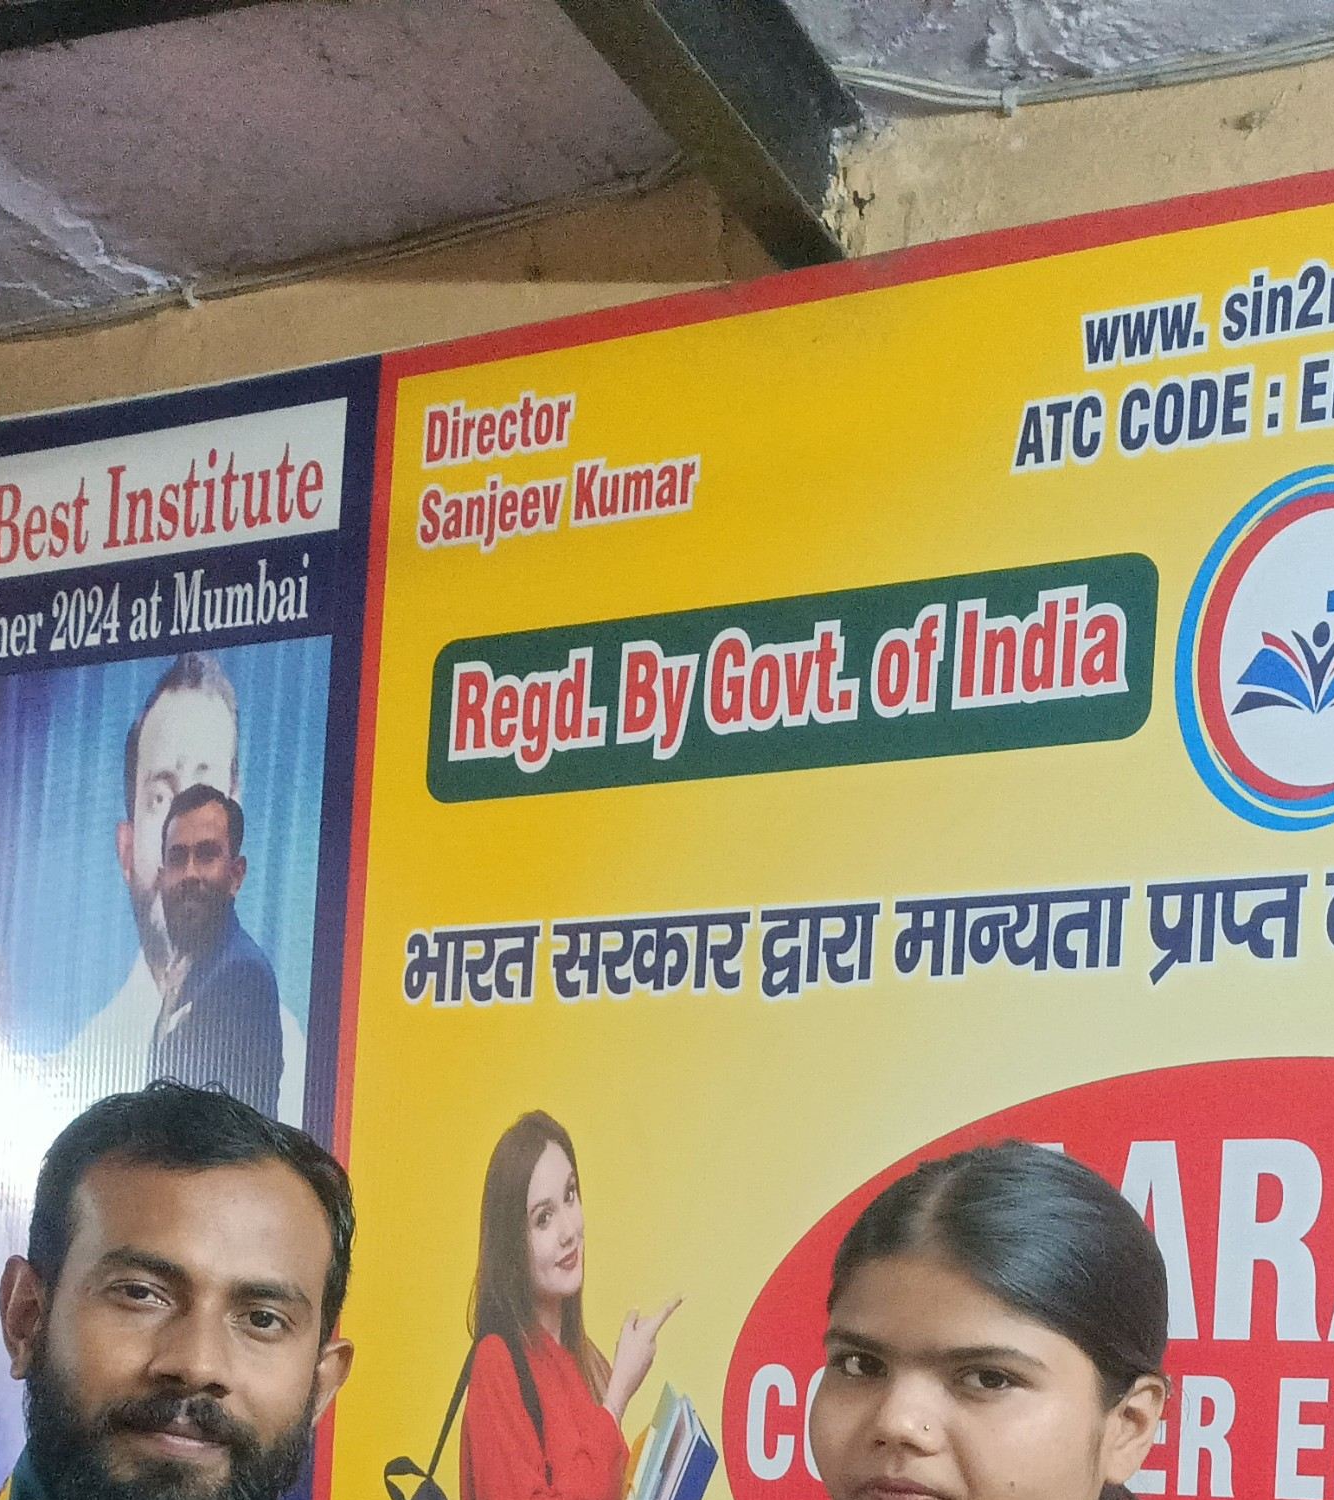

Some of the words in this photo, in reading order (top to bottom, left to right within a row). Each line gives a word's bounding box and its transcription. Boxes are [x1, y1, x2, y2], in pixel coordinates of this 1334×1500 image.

[1085, 309, 1205, 366] www.
[425, 392, 573, 465] Director
[1015, 394, 1102, 468] ATC
[1119, 373, 1251, 448] CODE
[102, 440, 326, 553] Institute
[419, 481, 562, 550] Sanjeev
[572, 457, 699, 522] Kumar
[51, 588, 120, 650] 2024
[129, 597, 163, 642] at
[170, 553, 311, 631] Mumbai
[453, 657, 600, 761] Regd.
[622, 651, 690, 749] By
[711, 632, 854, 725] Govt.
[877, 612, 938, 710] of
[959, 596, 1119, 698] India
[405, 923, 541, 1003] भारत
[552, 911, 750, 996] सरकार
[761, 903, 879, 996] द्वारा
[895, 886, 1131, 978] मान्यता
[1146, 874, 1309, 985] प्राप्त
